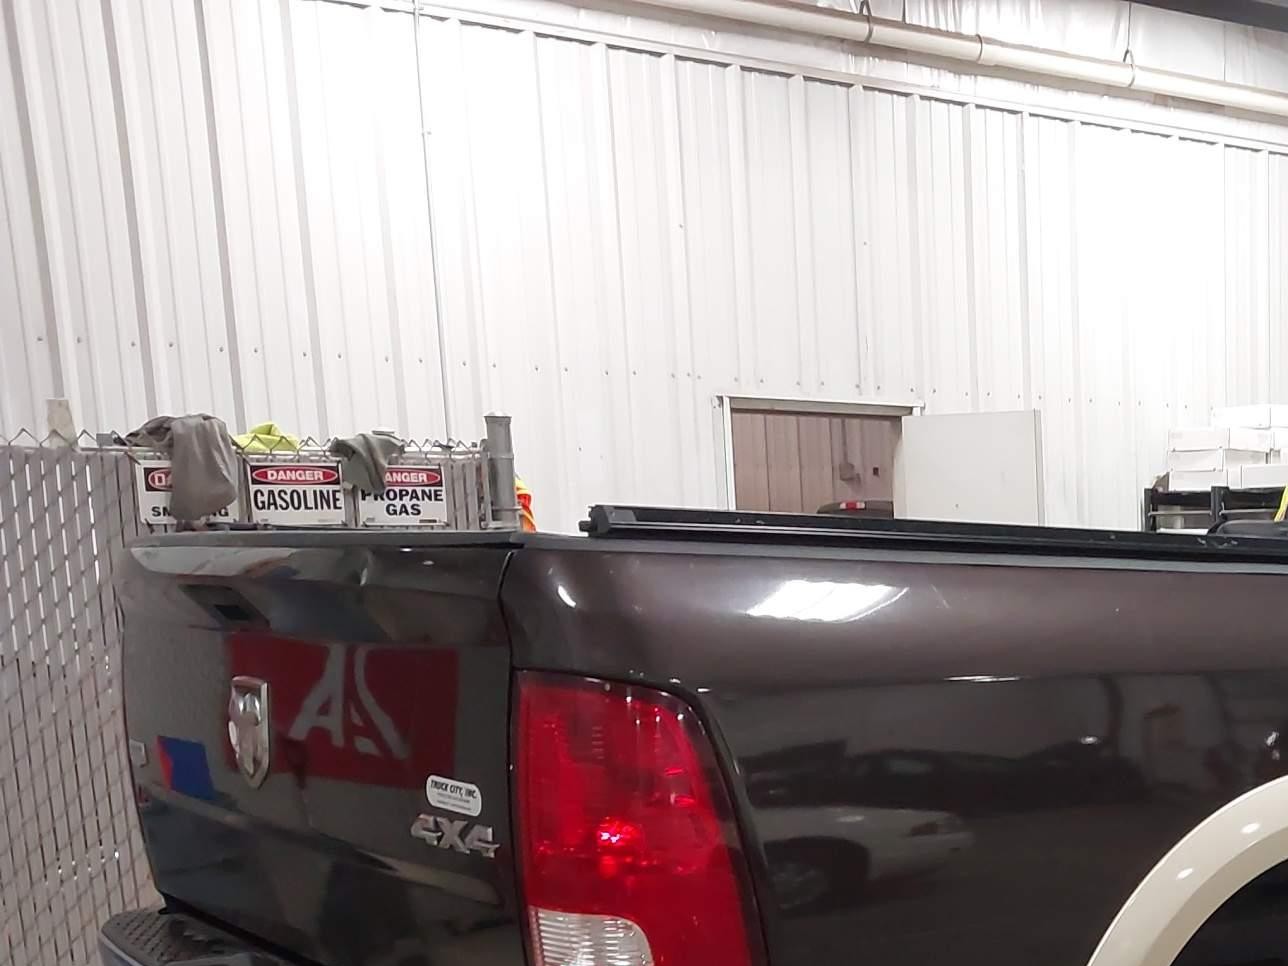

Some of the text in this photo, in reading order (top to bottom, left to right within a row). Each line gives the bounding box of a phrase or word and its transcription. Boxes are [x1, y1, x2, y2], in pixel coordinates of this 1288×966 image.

[267, 470, 324, 481] DANGER
[384, 472, 428, 482] ANGER
[253, 489, 342, 510] GASOLINE
[385, 503, 421, 516] GAS
[411, 814, 500, 858] 4X4
